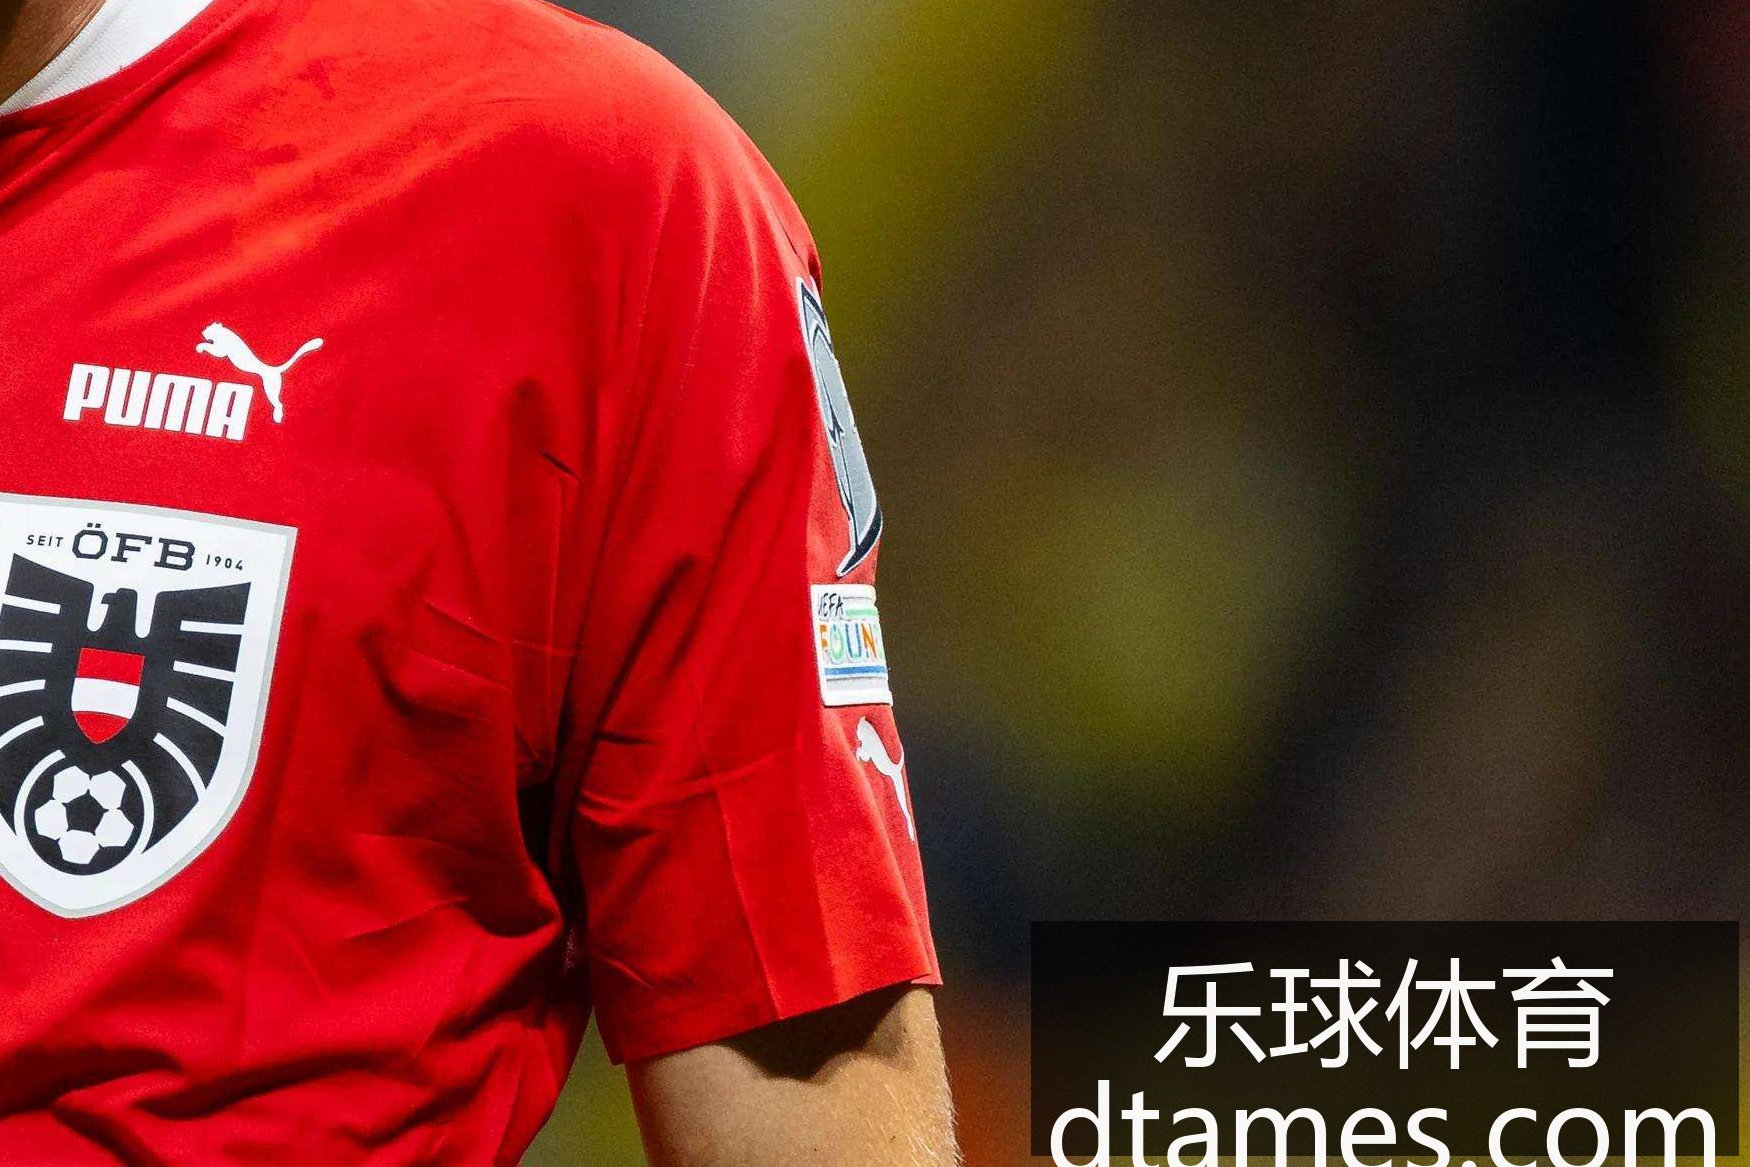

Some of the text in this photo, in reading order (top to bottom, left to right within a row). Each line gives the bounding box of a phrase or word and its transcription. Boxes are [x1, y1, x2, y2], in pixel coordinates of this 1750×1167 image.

[63, 363, 254, 442] PUMA
[26, 522, 244, 571] SEIT ÖFB 1904
